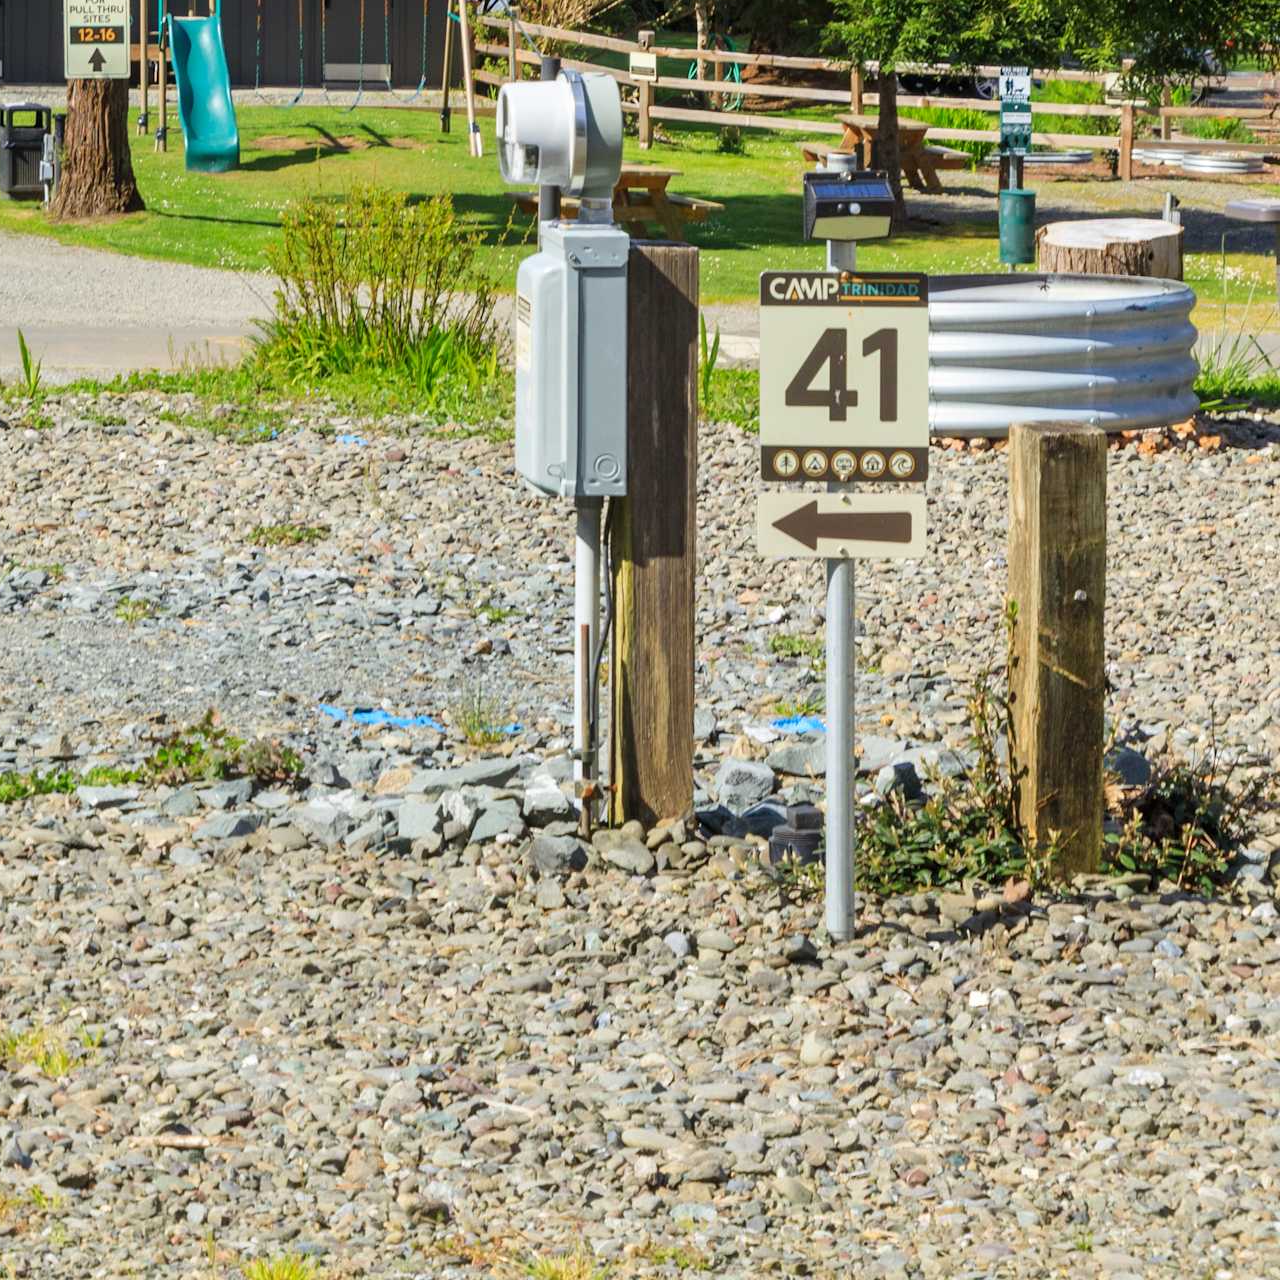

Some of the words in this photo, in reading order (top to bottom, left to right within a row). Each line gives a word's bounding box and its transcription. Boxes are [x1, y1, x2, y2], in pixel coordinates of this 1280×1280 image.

[69, 6, 93, 14] PULL
[97, 5, 124, 13] THRU
[83, 15, 111, 23] SITES
[78, 28, 116, 42] 12-16
[769, 277, 839, 301] CAMP
[842, 283, 919, 296] TRINIDAD
[785, 327, 898, 422] 41
